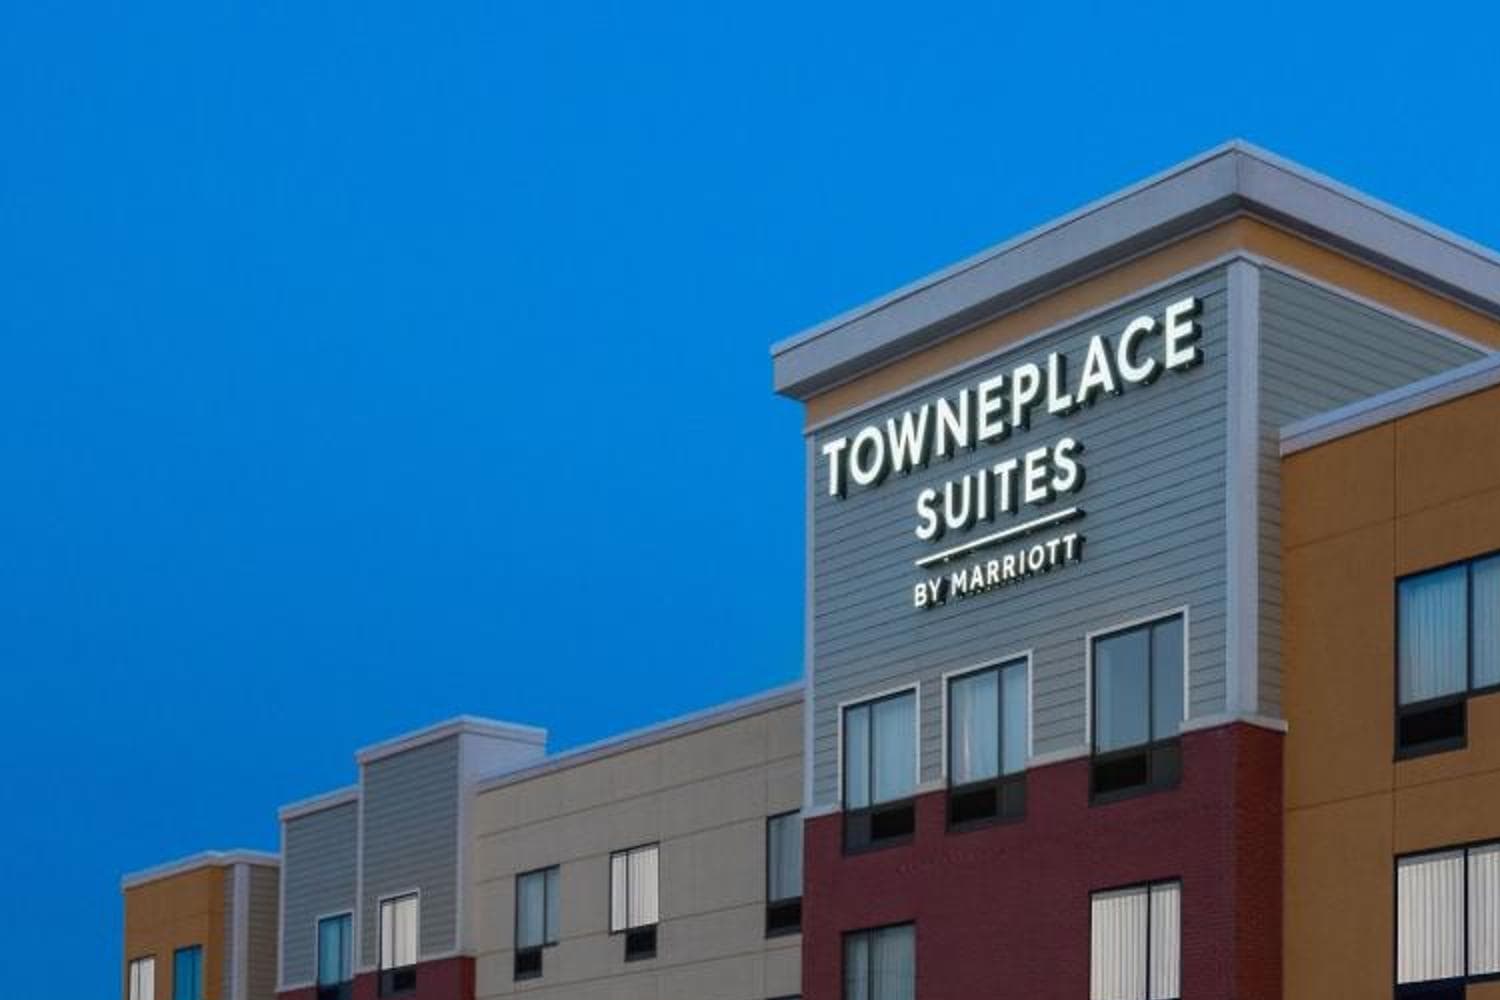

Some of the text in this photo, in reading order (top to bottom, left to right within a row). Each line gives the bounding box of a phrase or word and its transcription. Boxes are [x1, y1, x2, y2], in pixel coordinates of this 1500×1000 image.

[821, 296, 1196, 497] TOWNEPLACE
[914, 437, 1078, 541] SUITES
[914, 533, 1078, 607] BY MARRIOTT
